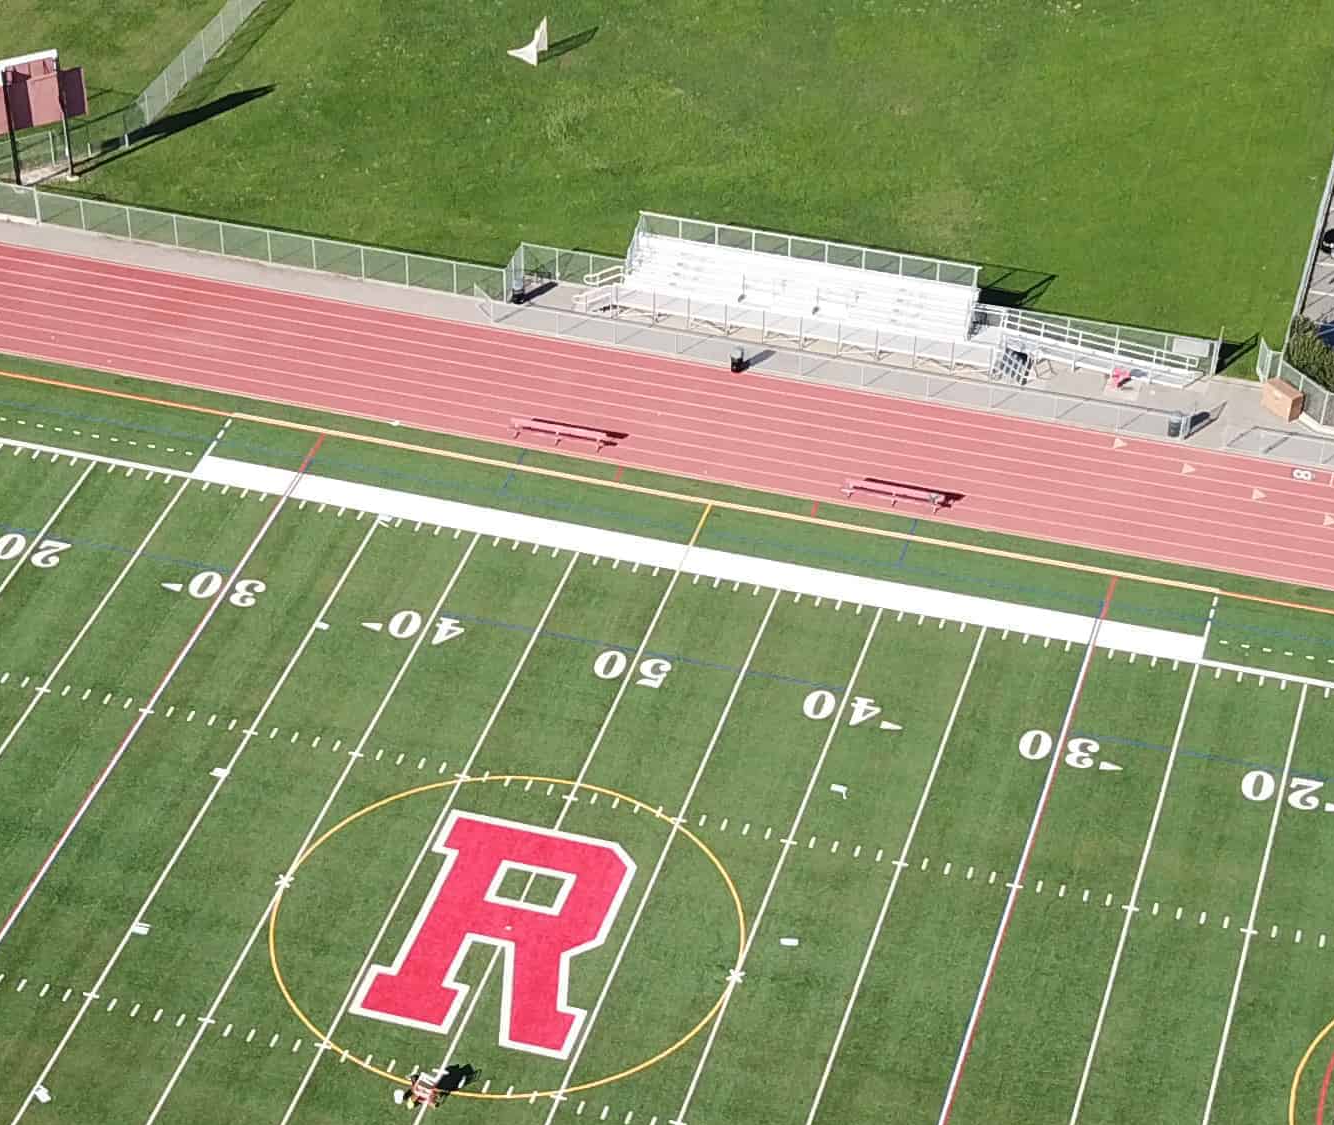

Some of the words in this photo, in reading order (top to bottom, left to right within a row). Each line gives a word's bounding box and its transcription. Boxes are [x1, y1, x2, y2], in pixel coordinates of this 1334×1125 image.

[1293, 468, 1312, 481] 8
[188, 571, 267, 607] 30
[387, 610, 465, 645] 40
[593, 650, 671, 689] 50
[802, 690, 883, 727] 40
[1018, 729, 1101, 769] 30
[1240, 769, 1325, 811] 20
[349, 809, 637, 1059] R
